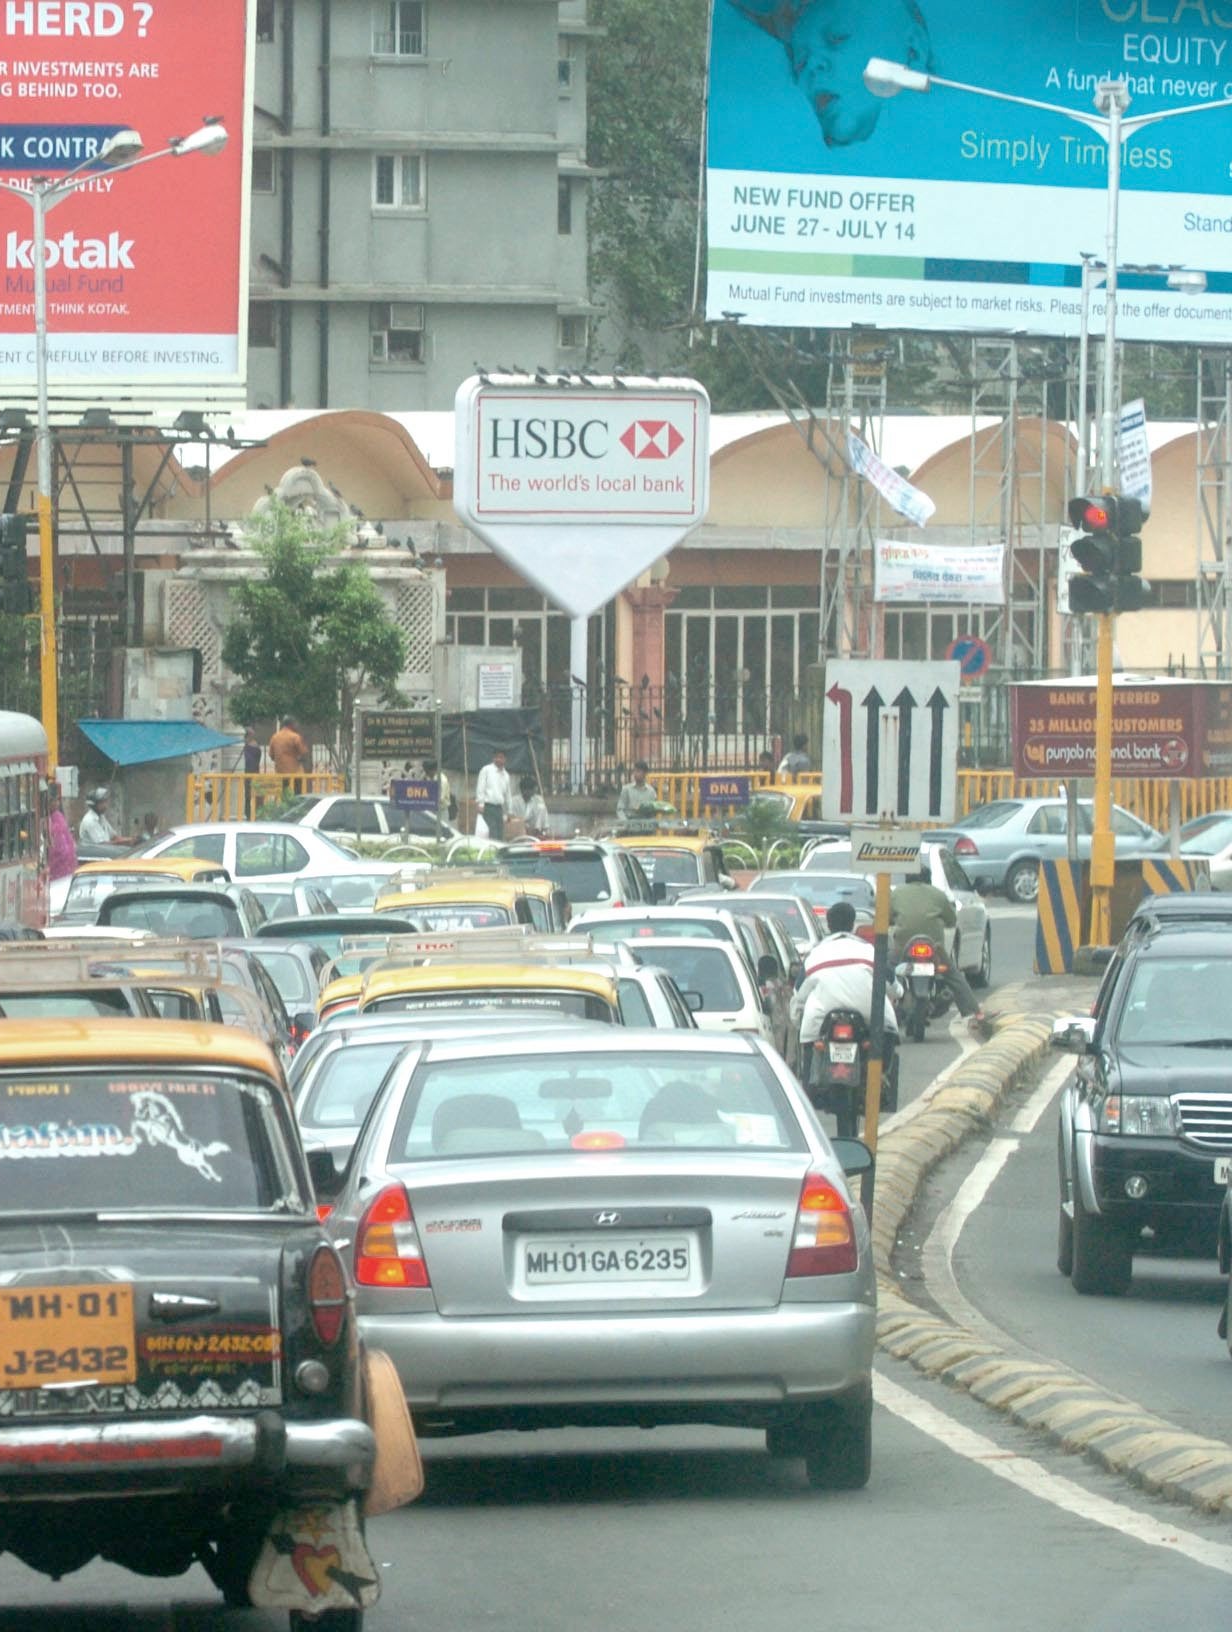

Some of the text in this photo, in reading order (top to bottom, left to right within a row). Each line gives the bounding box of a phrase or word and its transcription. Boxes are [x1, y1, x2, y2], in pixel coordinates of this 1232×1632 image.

[1123, 33, 1227, 66] EQUITY
[13, 62, 124, 77] INVESTMENTS
[129, 63, 159, 77] ARE
[18, 83, 78, 97] BEHIND
[83, 83, 122, 98] TOO.
[1045, 67, 1060, 89] A
[1161, 78, 1217, 98] never
[960, 130, 1173, 169] Simply Timless
[733, 186, 915, 213] NEW FUND OFFER
[731, 214, 786, 235] JUNE
[797, 217, 819, 236] 27
[836, 219, 887, 239] JULY
[895, 222, 915, 241] 14
[6, 231, 135, 269] kotak
[6, 275, 123, 293] Muual Fund
[50, 303, 84, 315] THINK
[88, 303, 130, 316] KOTAK.
[728, 284, 770, 301] Mutual
[774, 286, 805, 302] Fund
[809, 288, 882, 305] investments
[887, 294, 905, 306] are
[909, 295, 952, 311] subject
[956, 297, 968, 309] to
[971, 297, 1011, 311] market
[1050, 299, 1082, 316] Pleas
[1122, 303, 1137, 316] the
[1143, 303, 1170, 318] offer
[26, 350, 98, 364] CREFULLY
[102, 350, 148, 364] BEFORE
[489, 418, 608, 459] HSBC
[488, 473, 685, 492] The world's local bank
[1049, 691, 1085, 705] BANK
[1029, 719, 1044, 733] 35
[1048, 719, 1097, 733] MILLIO
[1133, 742, 1161, 760] bank
[406, 786, 429, 798] DNA
[710, 783, 739, 795] DNA
